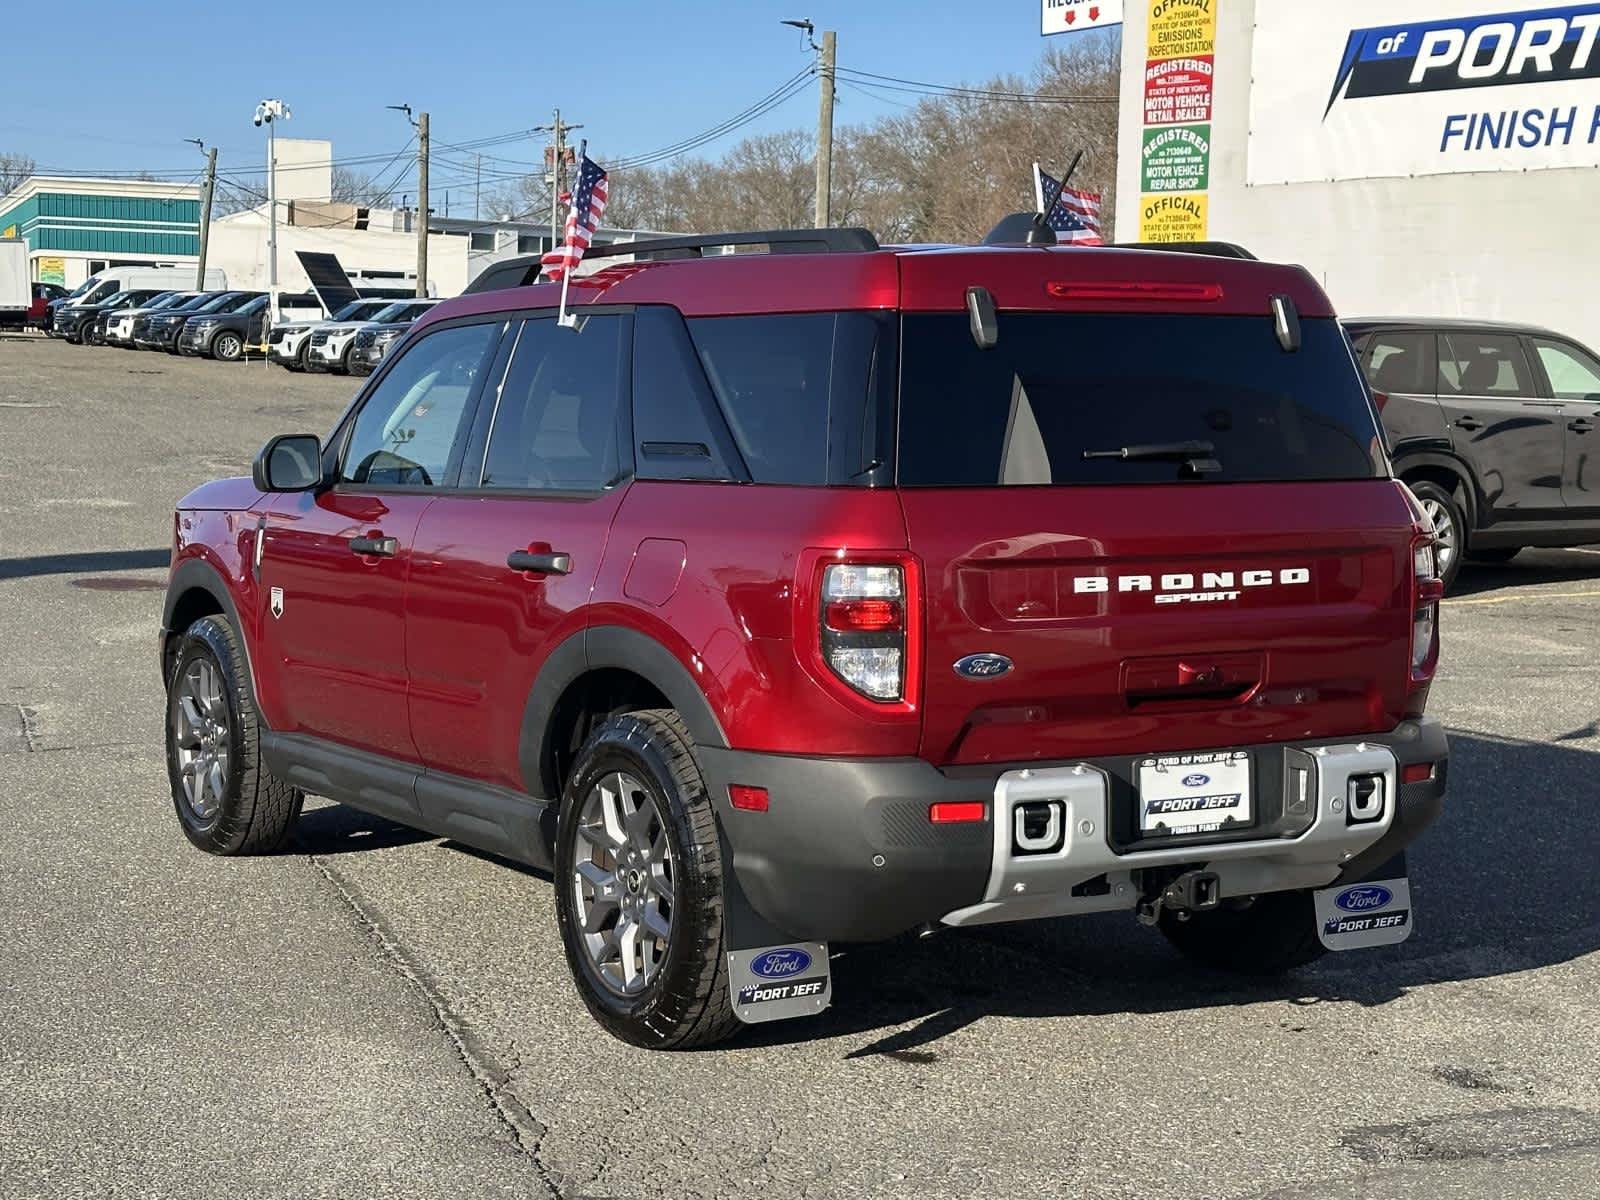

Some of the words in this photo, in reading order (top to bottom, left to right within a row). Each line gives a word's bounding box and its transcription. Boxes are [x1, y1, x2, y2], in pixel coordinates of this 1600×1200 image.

[1152, 22, 1169, 31] STATE
[1158, 28, 1202, 43] EMISSIONS
[1148, 43, 1185, 56] INSPECTION
[1185, 40, 1213, 53] STATION
[1376, 32, 1408, 54] of
[1408, 13, 1600, 83] PORT
[1147, 59, 1212, 80] REGISTERED
[1149, 88, 1166, 96] STATE
[1145, 96, 1173, 110] MOTOR
[1175, 93, 1210, 107] VEHICLE
[1147, 110, 1173, 123] RETAIL
[1175, 107, 1206, 121] DEALER
[1440, 106, 1577, 152] FINISH
[1143, 128, 1208, 158] REGISTERED
[1146, 166, 1172, 178] MOTOR
[1173, 165, 1204, 176] VEHICLE
[1150, 179, 1177, 190] REPAIR
[1178, 178, 1199, 188] SHOP
[1145, 197, 1200, 219] OFFICIAL
[1148, 233, 1170, 241] HEAVY
[1173, 232, 1195, 240] TRUCK
[1073, 568, 1309, 593] BRONCO
[1154, 591, 1240, 604] SPORT
[969, 660, 1000, 673] Ford
[1158, 757, 1179, 765] FORD
[1193, 754, 1214, 763] PORT
[1214, 752, 1231, 761] JEFF
[1187, 775, 1205, 785] Ford
[1161, 799, 1201, 812] PORT
[1202, 796, 1236, 808] JEFF
[1200, 823, 1220, 832] FIRST
[1347, 889, 1380, 908] Ford
[1338, 920, 1372, 932] PORT
[1373, 916, 1403, 928] JEFF
[763, 953, 800, 974] Ford
[753, 987, 790, 1002] PORT
[791, 982, 822, 997] JEFF
